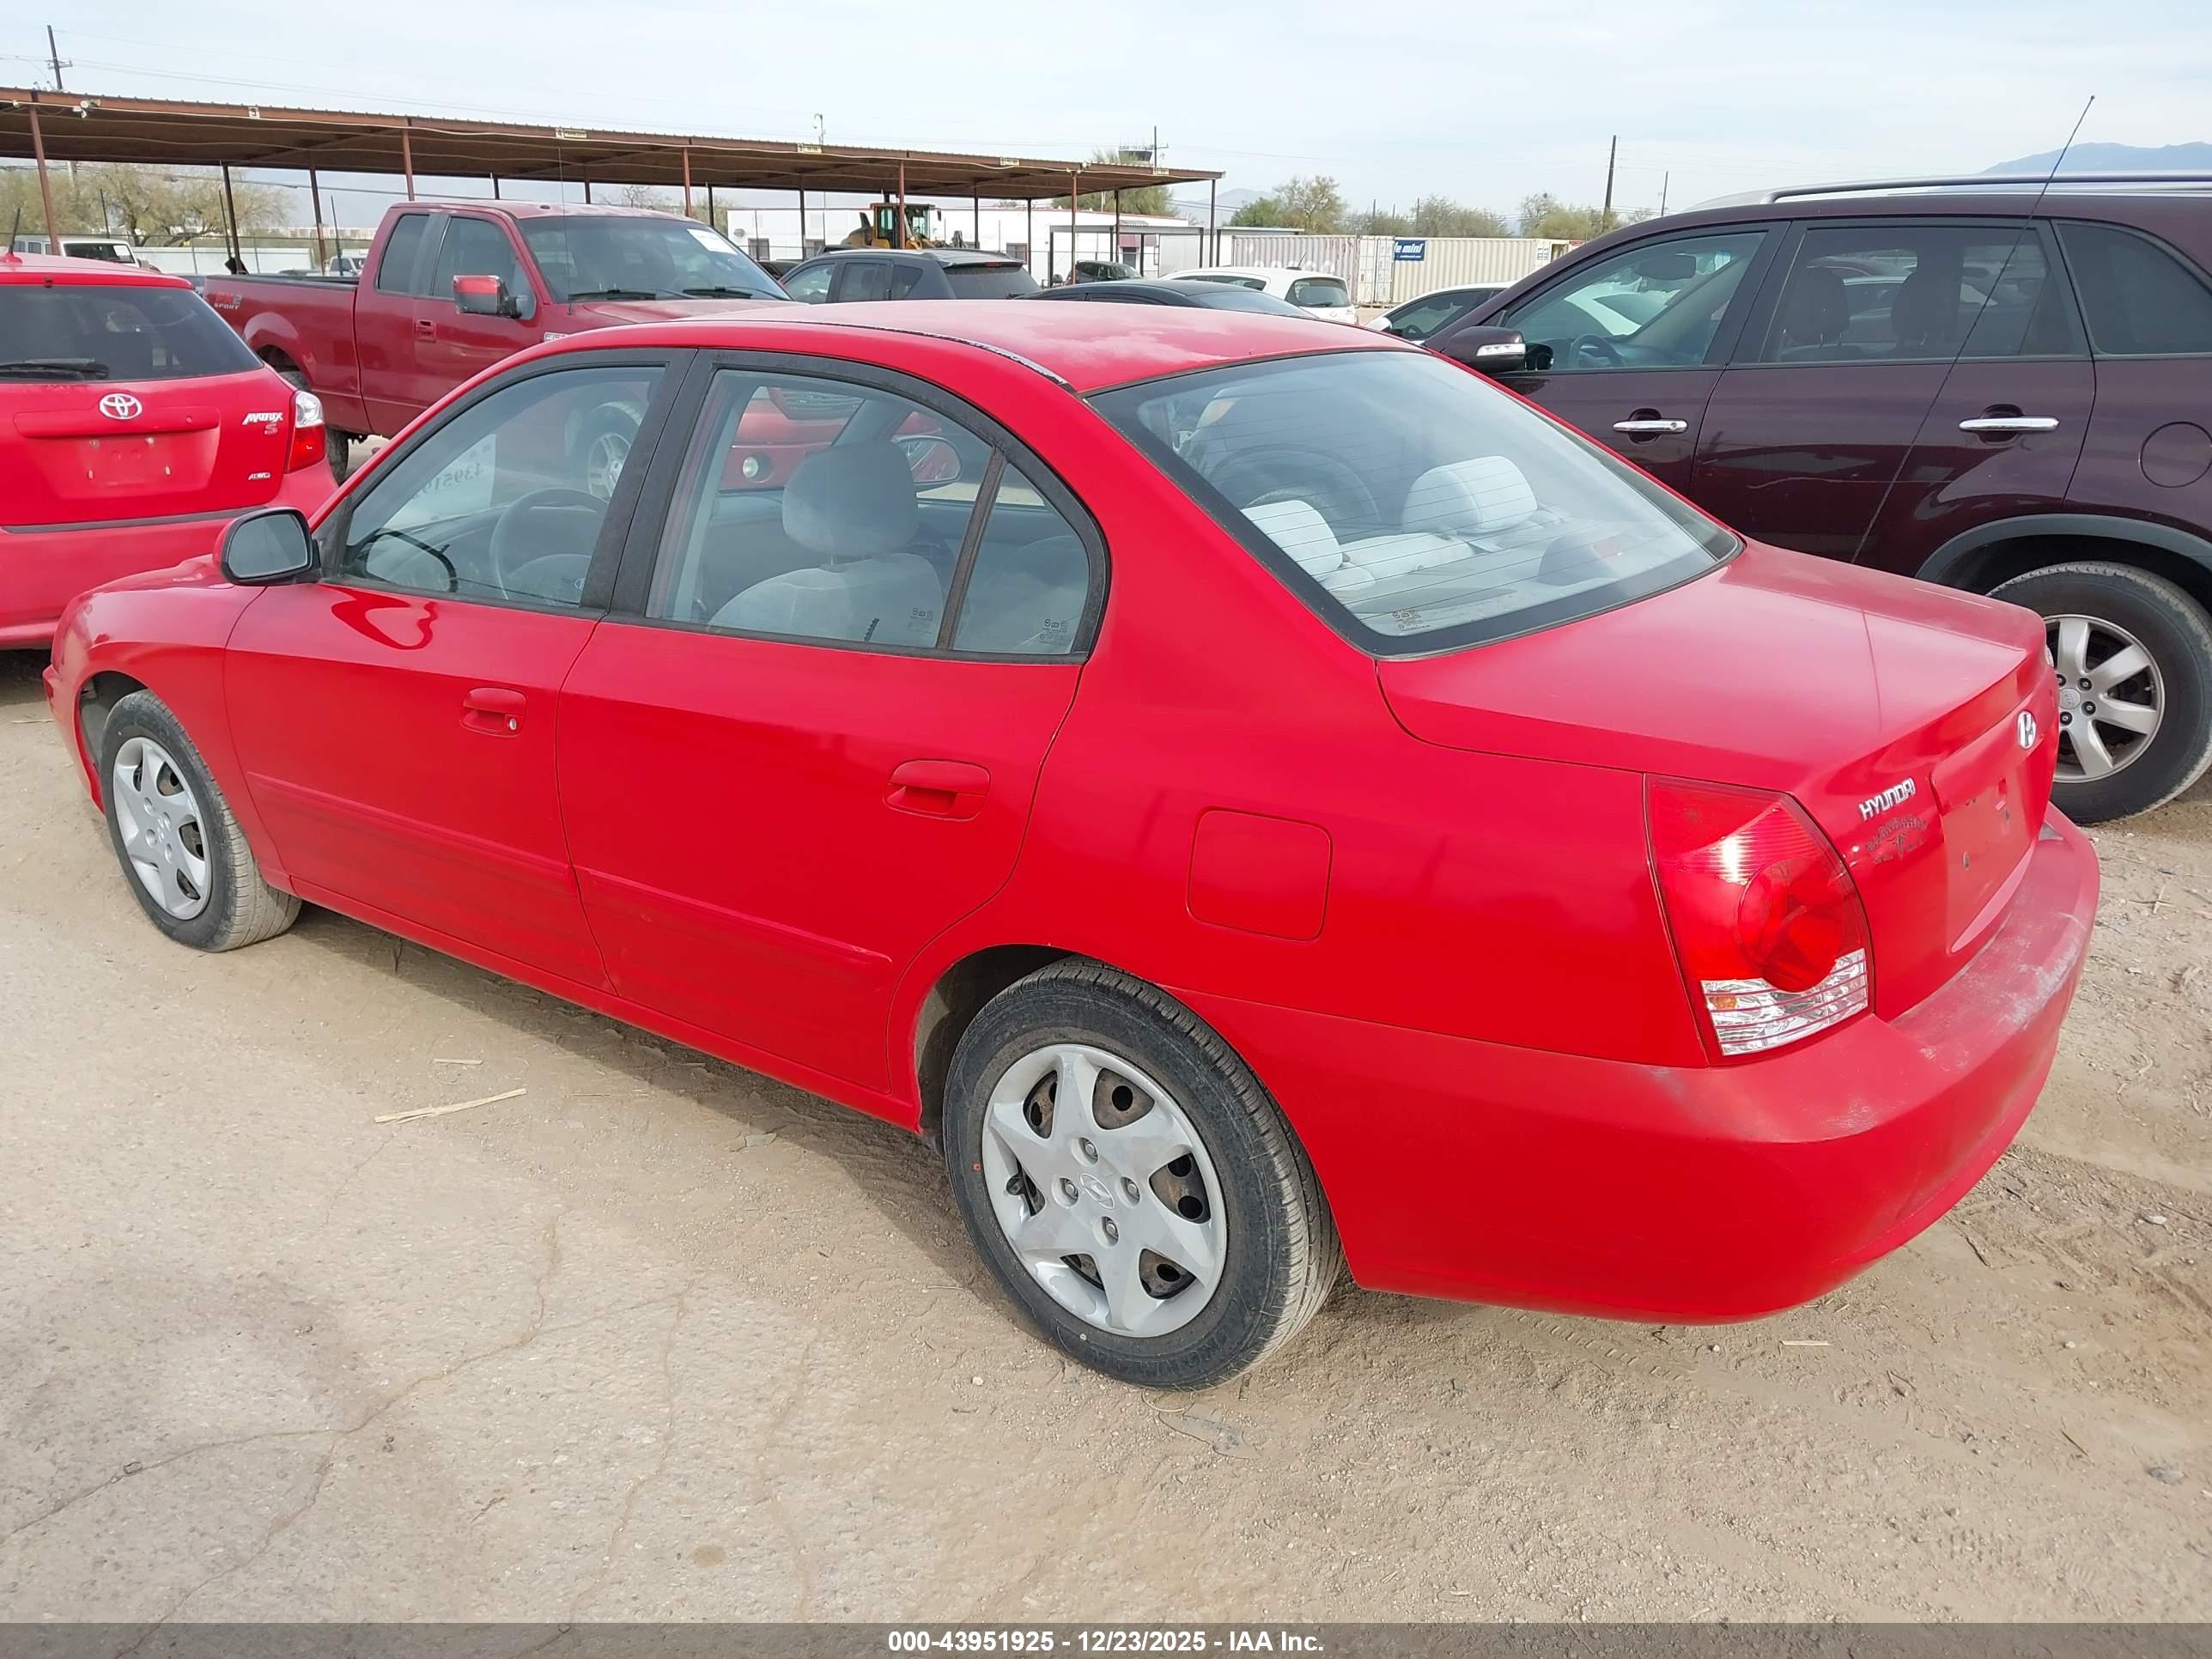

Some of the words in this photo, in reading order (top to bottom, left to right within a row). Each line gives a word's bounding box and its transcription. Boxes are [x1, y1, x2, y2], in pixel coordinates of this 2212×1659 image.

[1401, 242, 1424, 252] mini
[214, 301, 240, 310] SPORT
[242, 412, 284, 426] MATRIX
[264, 422, 278, 435] S
[248, 472, 270, 481] AWD
[1858, 777, 1916, 821] HYUNDAI
